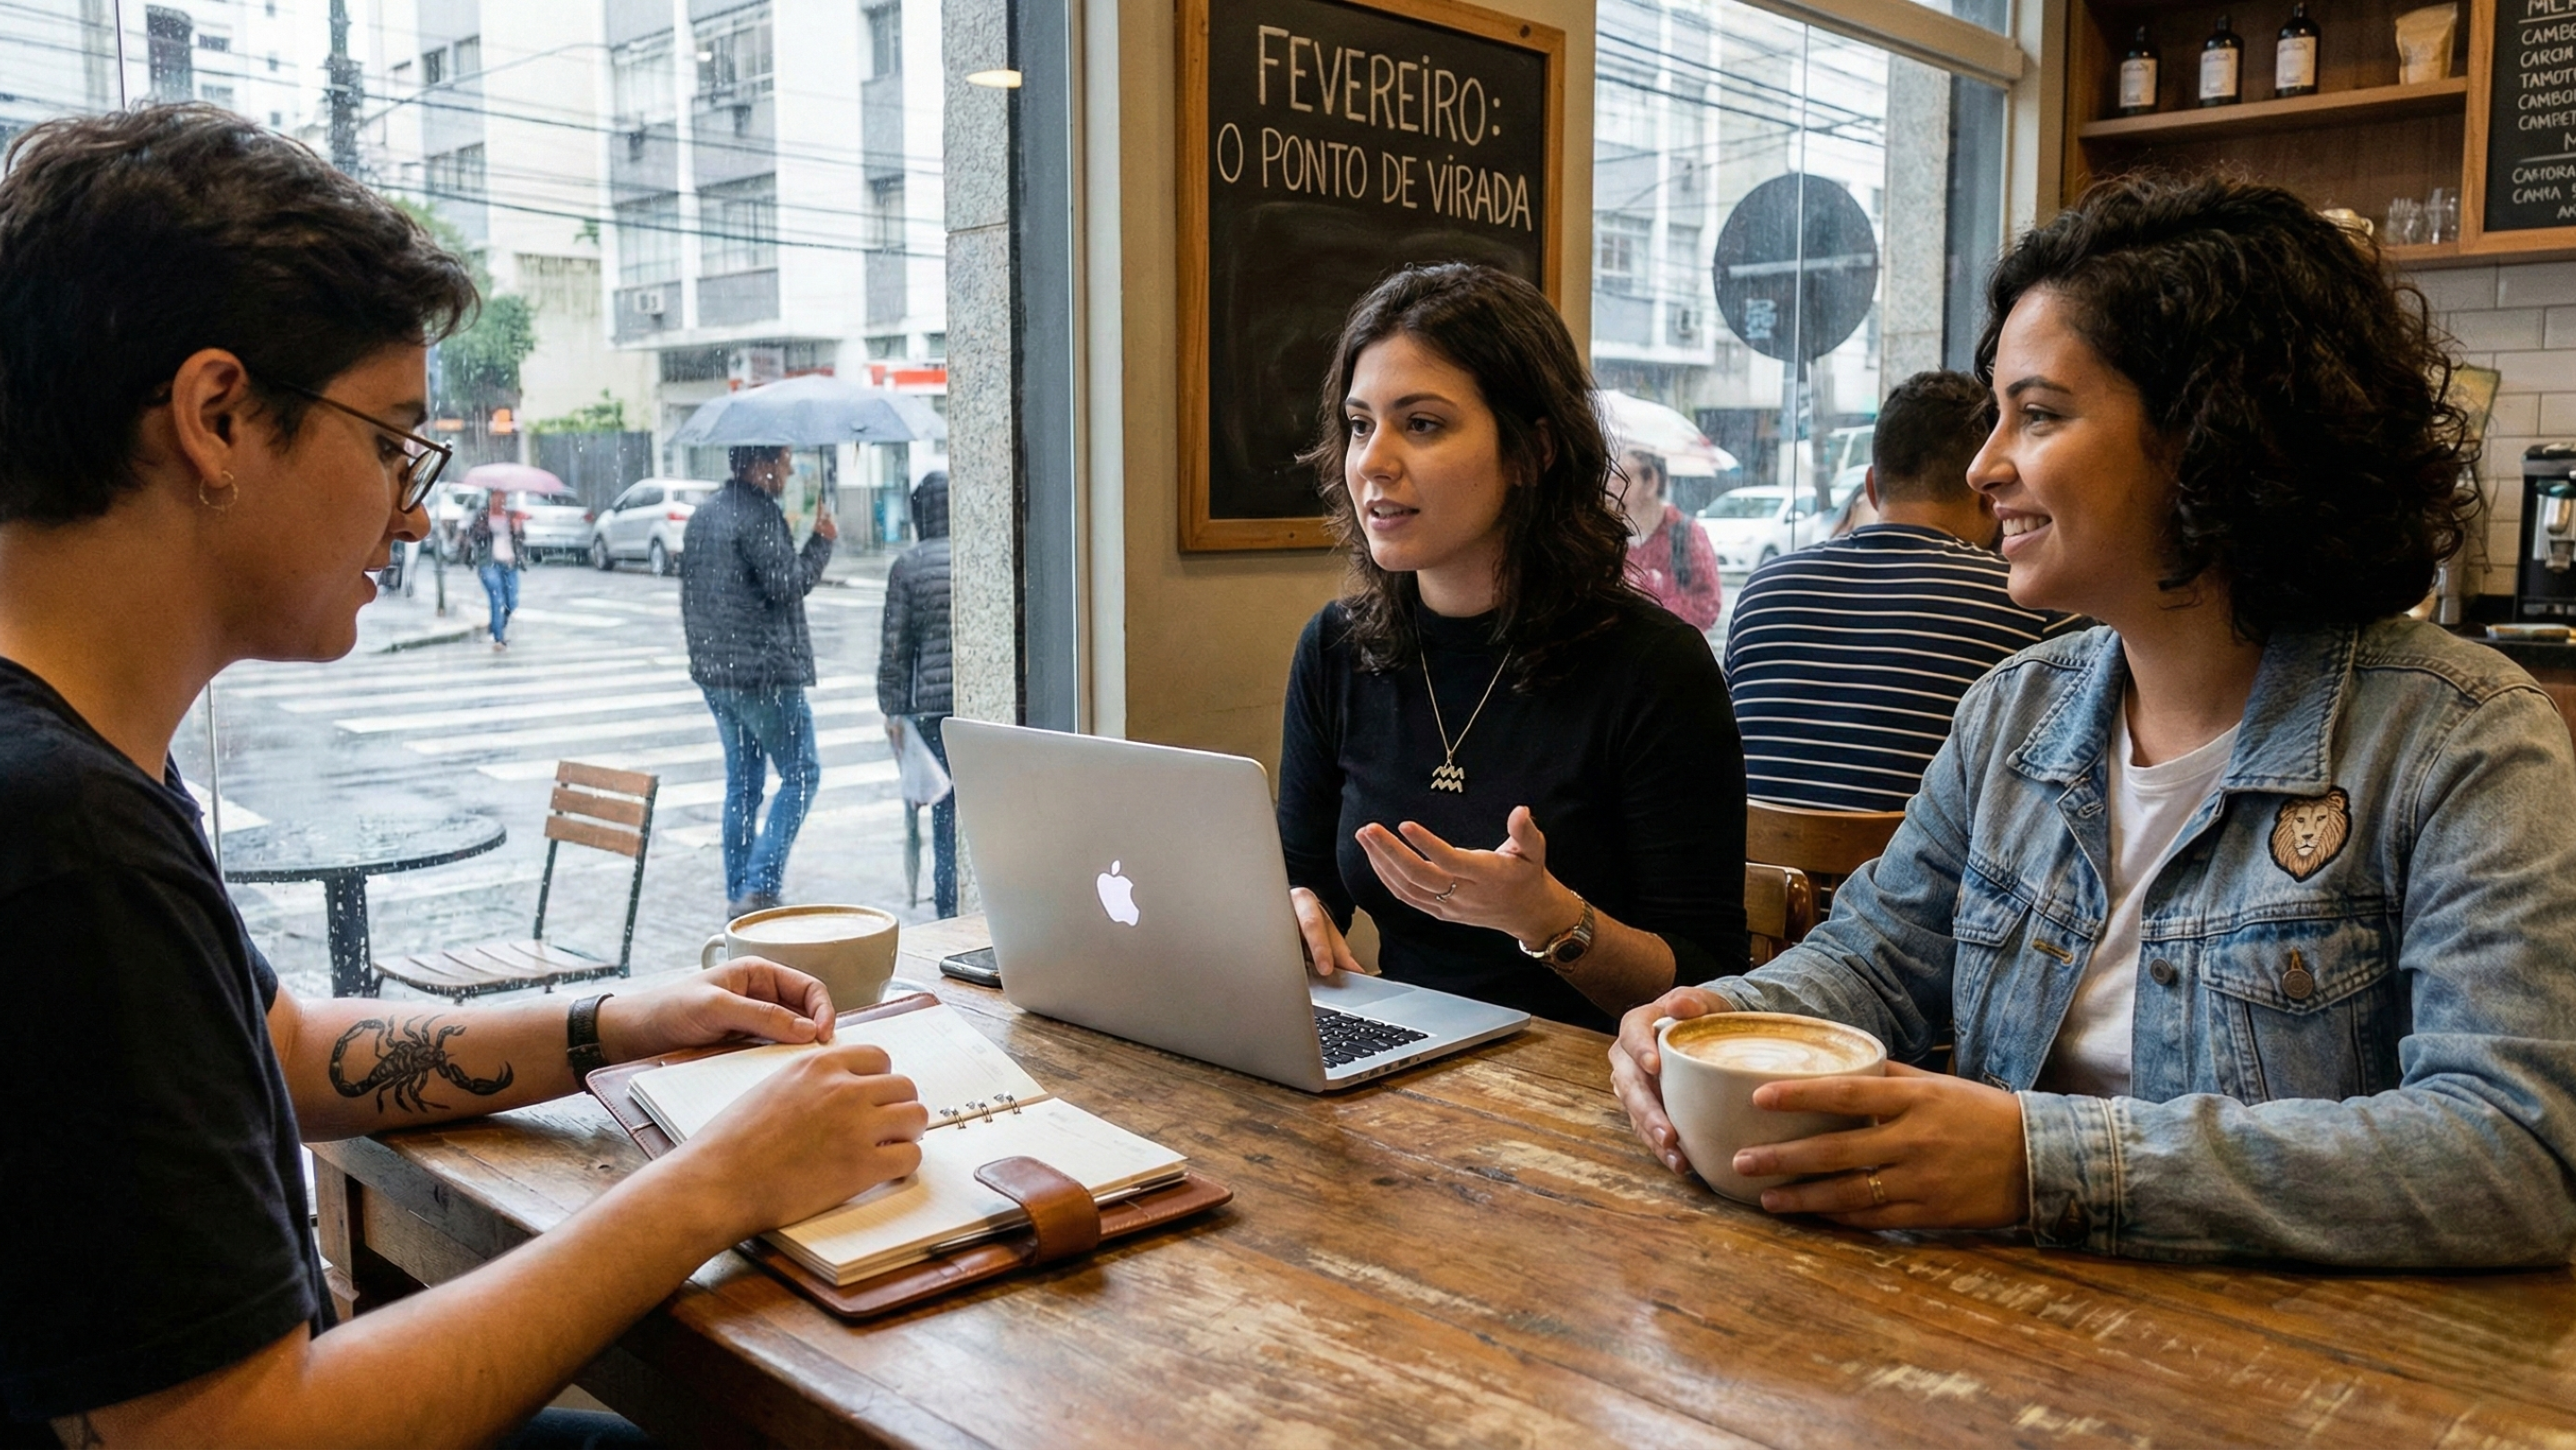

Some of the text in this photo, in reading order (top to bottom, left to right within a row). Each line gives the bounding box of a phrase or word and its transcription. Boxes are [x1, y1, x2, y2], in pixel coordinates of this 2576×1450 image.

[1258, 24, 1501, 147] FEVEREIRO:
[2518, 89, 2576, 110] CAMBO
[2519, 67, 2576, 89] TAMOT
[1217, 123, 1532, 233] O PONTO DE VIRADA
